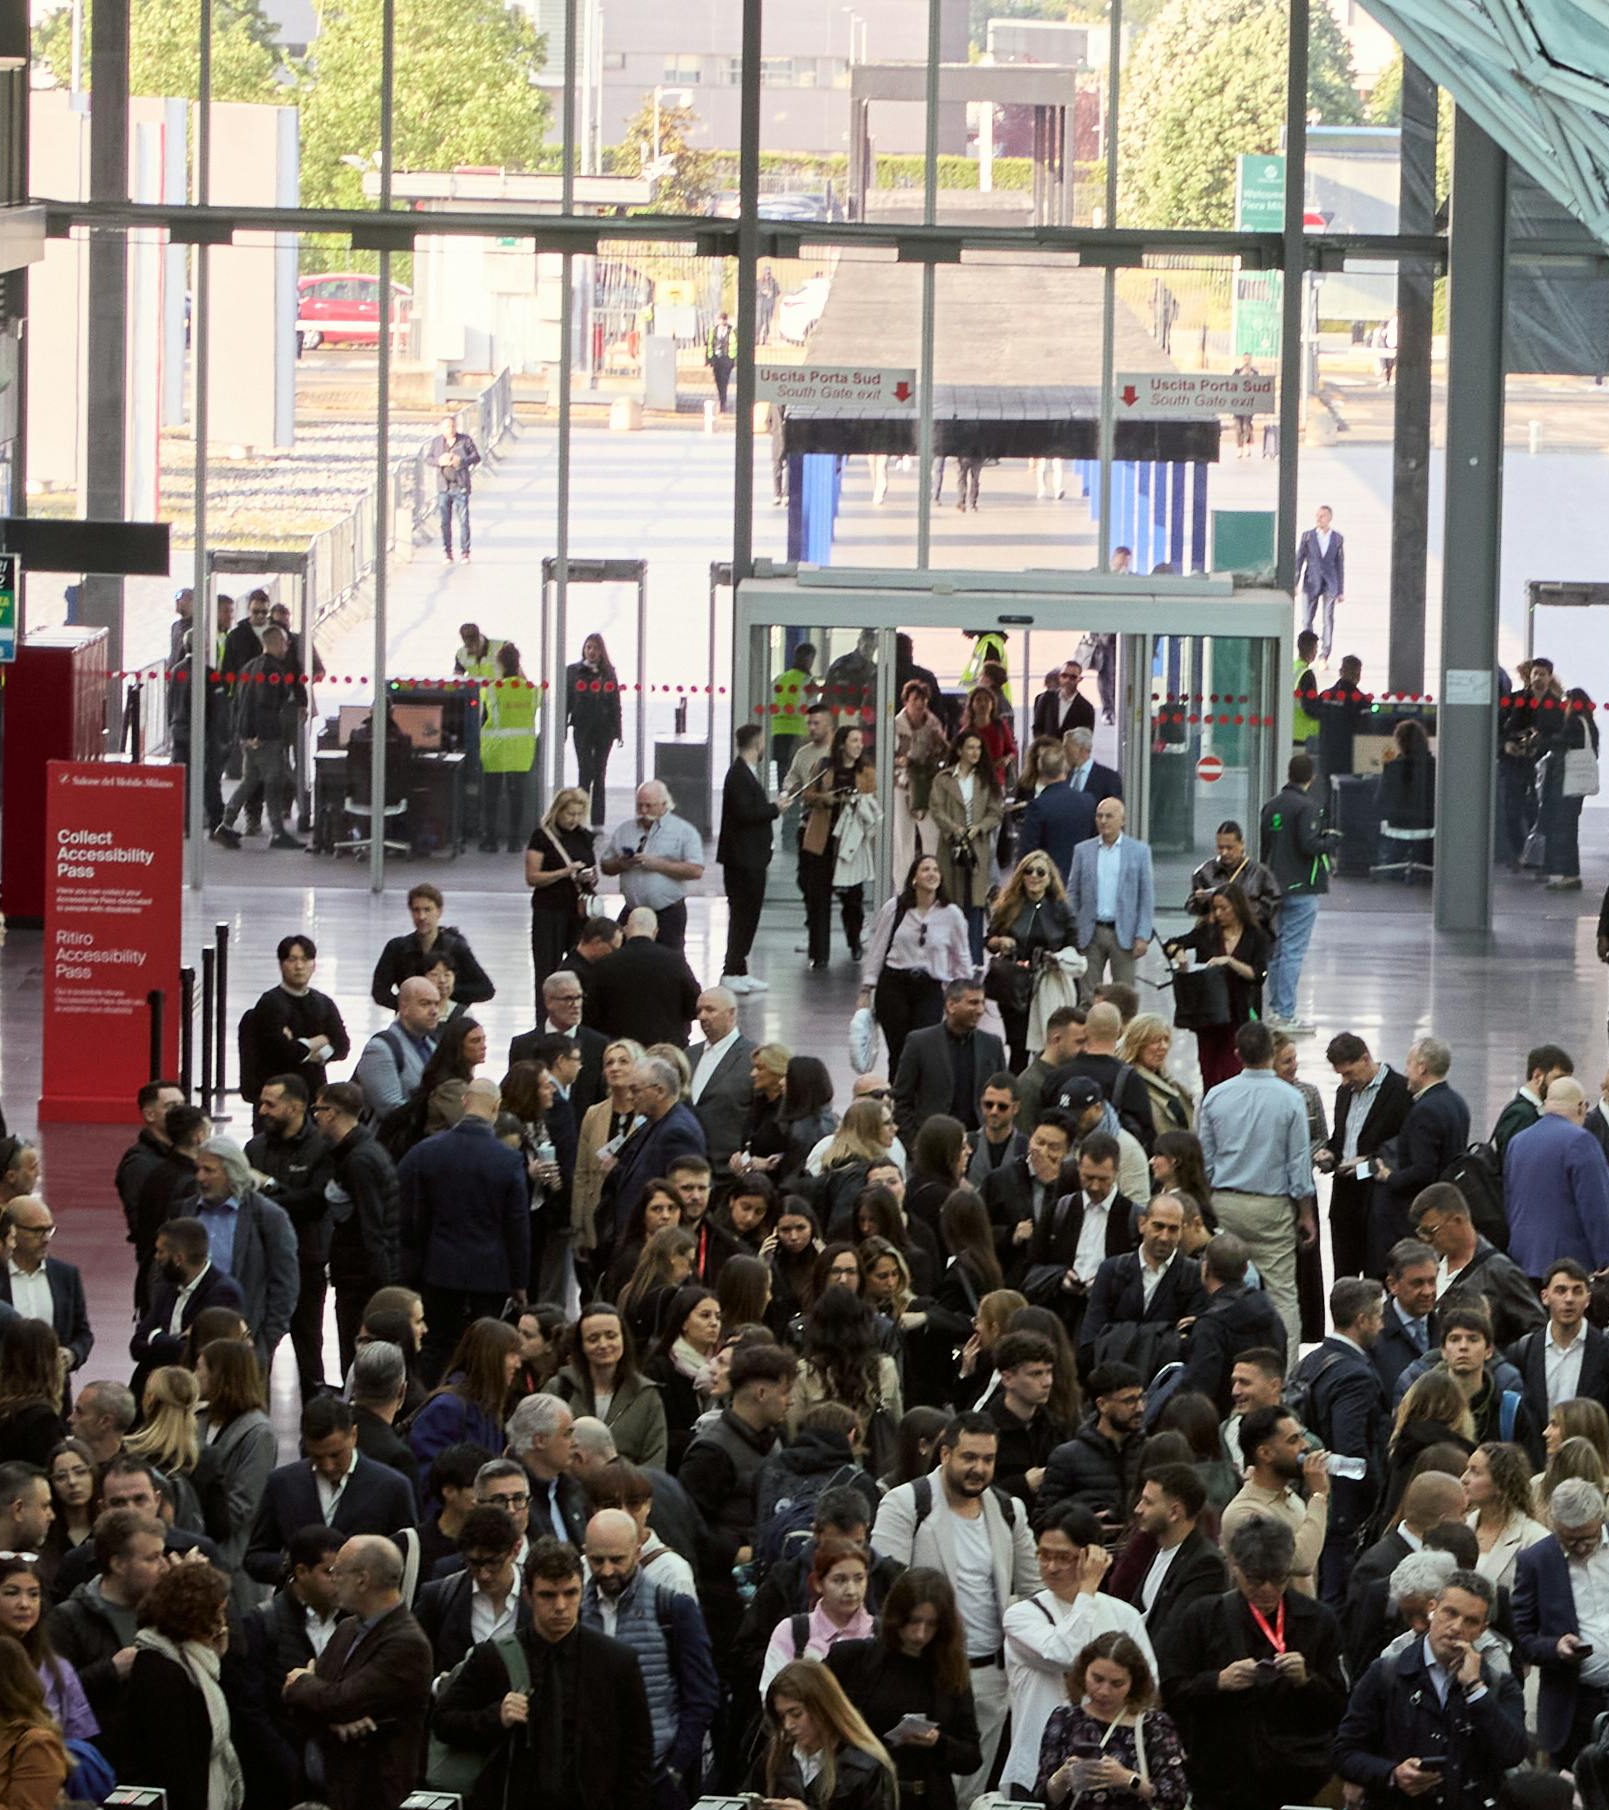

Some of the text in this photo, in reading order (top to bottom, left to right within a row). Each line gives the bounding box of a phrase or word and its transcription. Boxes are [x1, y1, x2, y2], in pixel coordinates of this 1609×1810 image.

[760, 369, 881, 385] Uscita Porta Sud
[777, 385, 882, 400] South Gate exit
[1151, 378, 1272, 393] Uscita Porta Sud
[1151, 394, 1255, 407] South Gate exit
[57, 829, 113, 845] Collect
[57, 846, 154, 866] Accessibility
[57, 863, 95, 878] Pass
[56, 929, 94, 945] Ritiro
[55, 947, 147, 967] Accessibility
[55, 964, 92, 979] Pass
